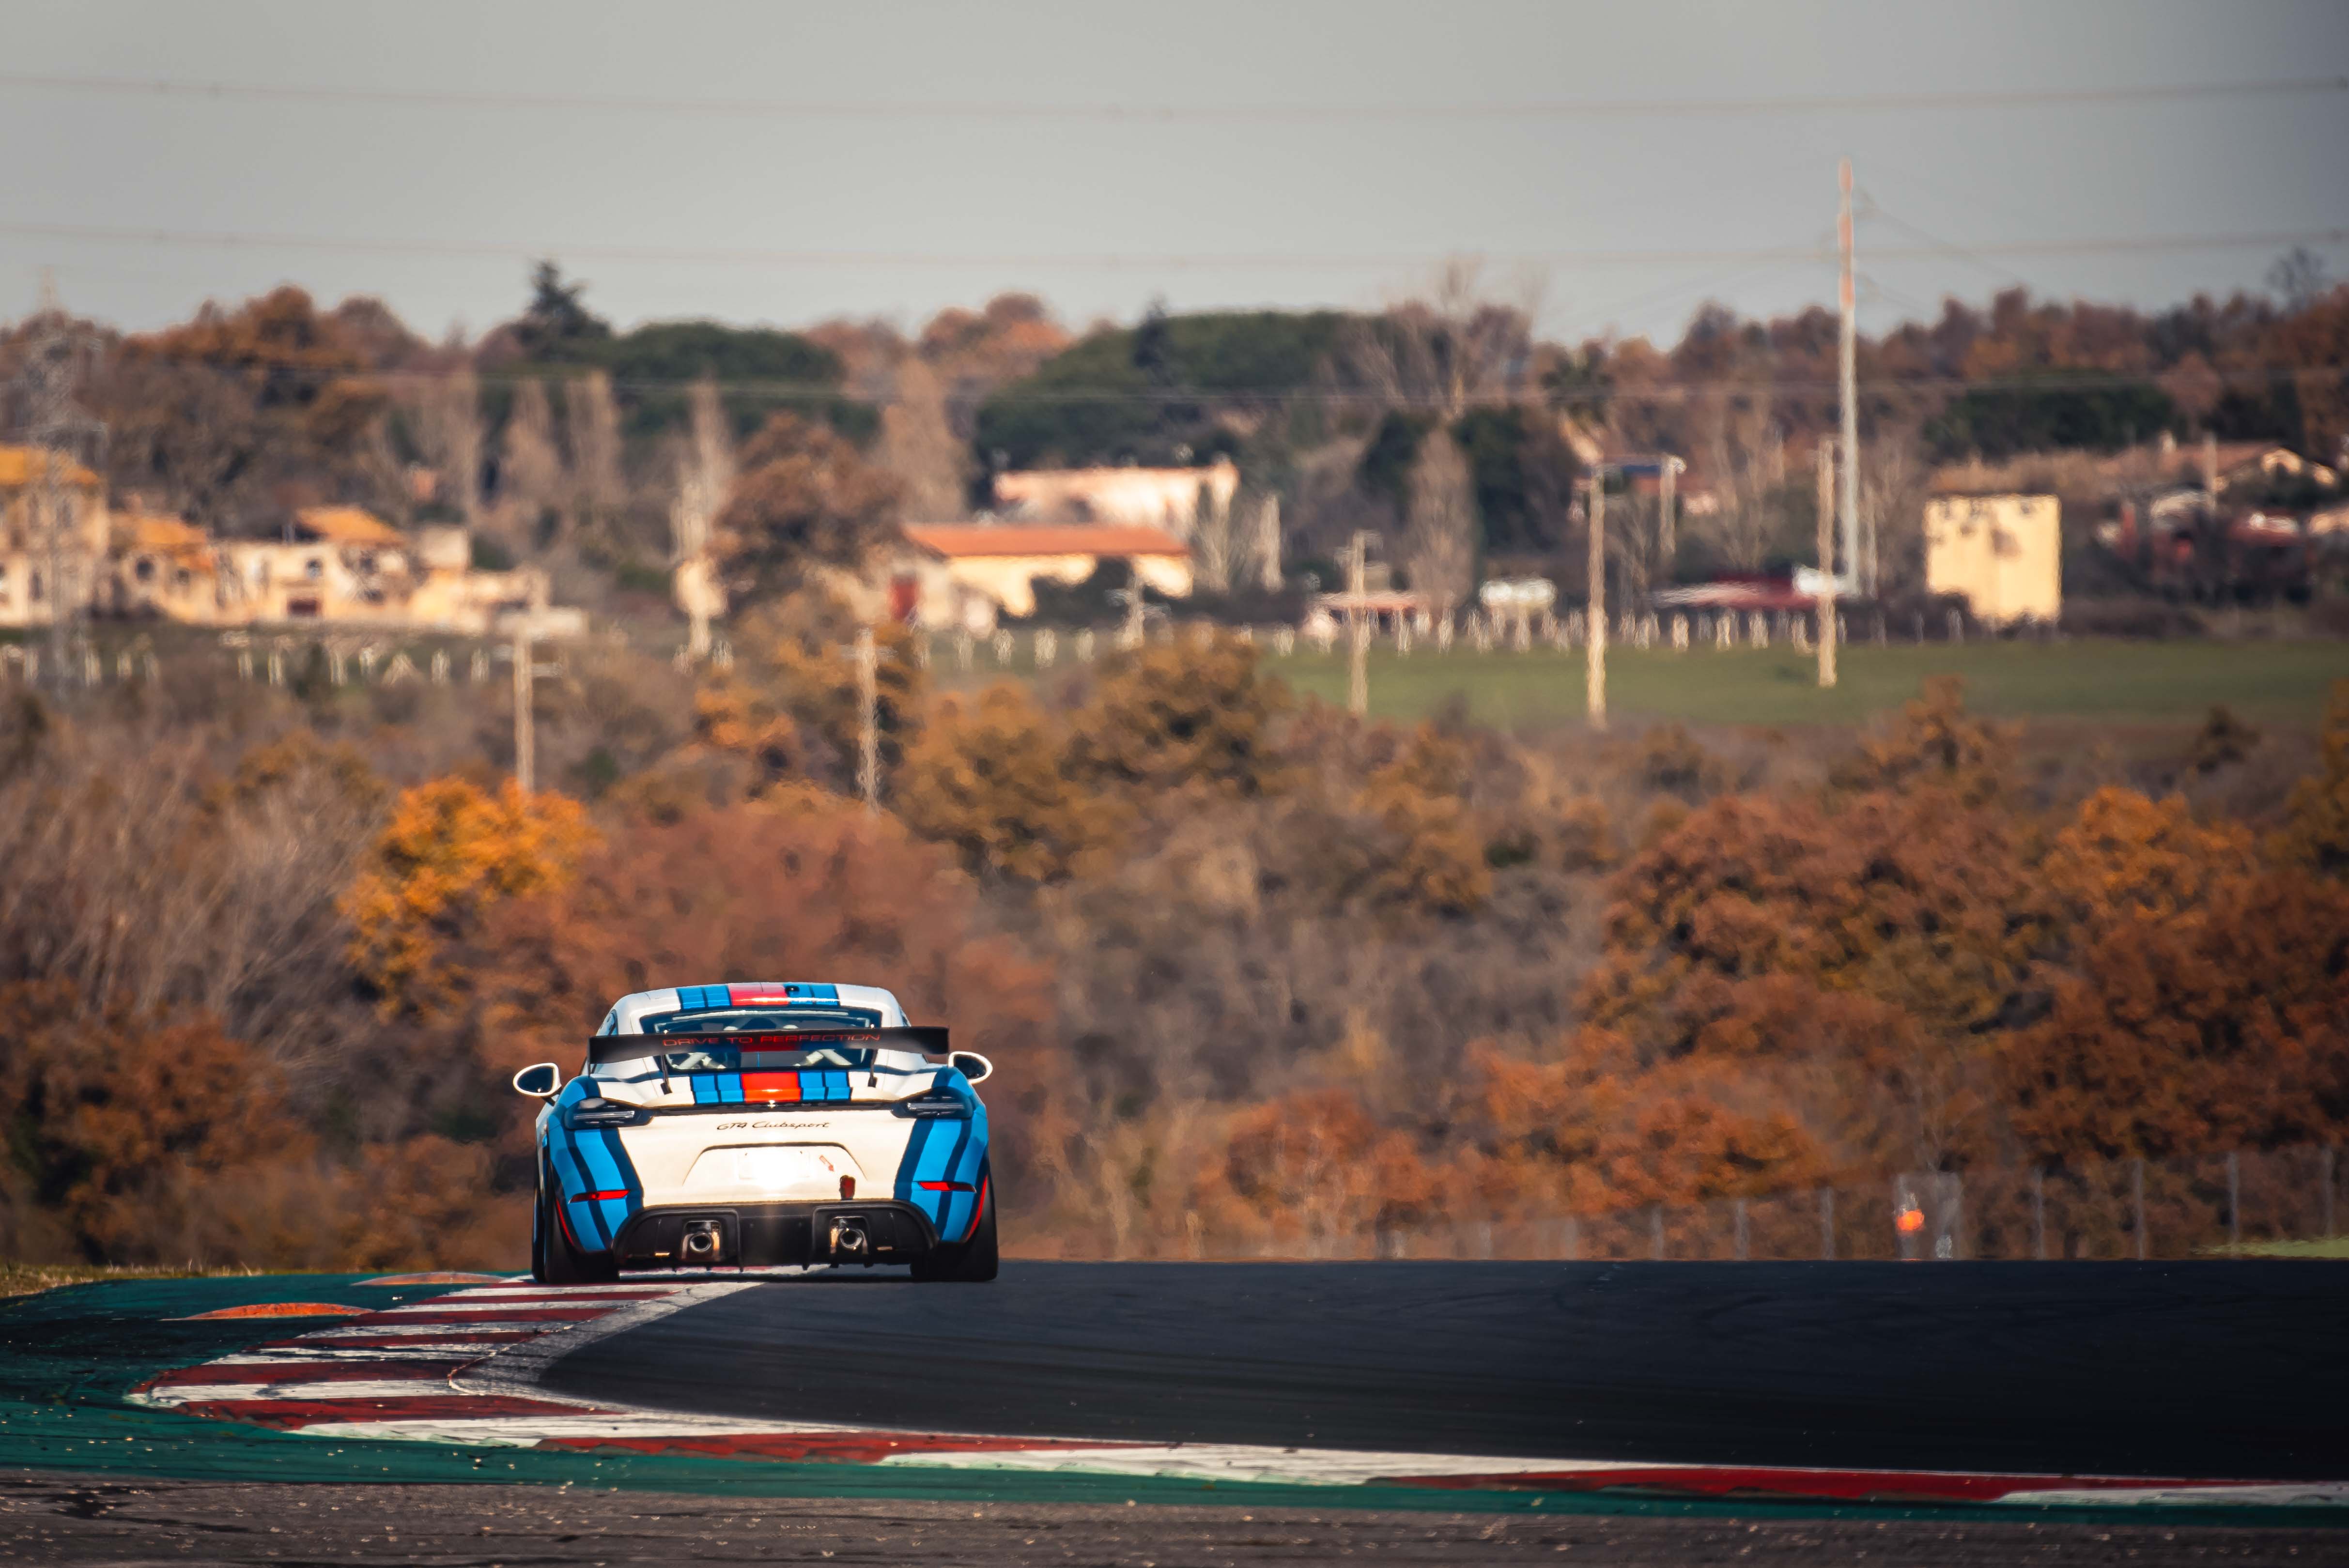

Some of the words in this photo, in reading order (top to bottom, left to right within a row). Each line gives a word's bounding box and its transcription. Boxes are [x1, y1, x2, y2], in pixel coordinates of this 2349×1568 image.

[662, 1037, 720, 1046] DRIVE
[760, 1034, 880, 1043] PERFECTION
[752, 1121, 830, 1129] Clubsport
